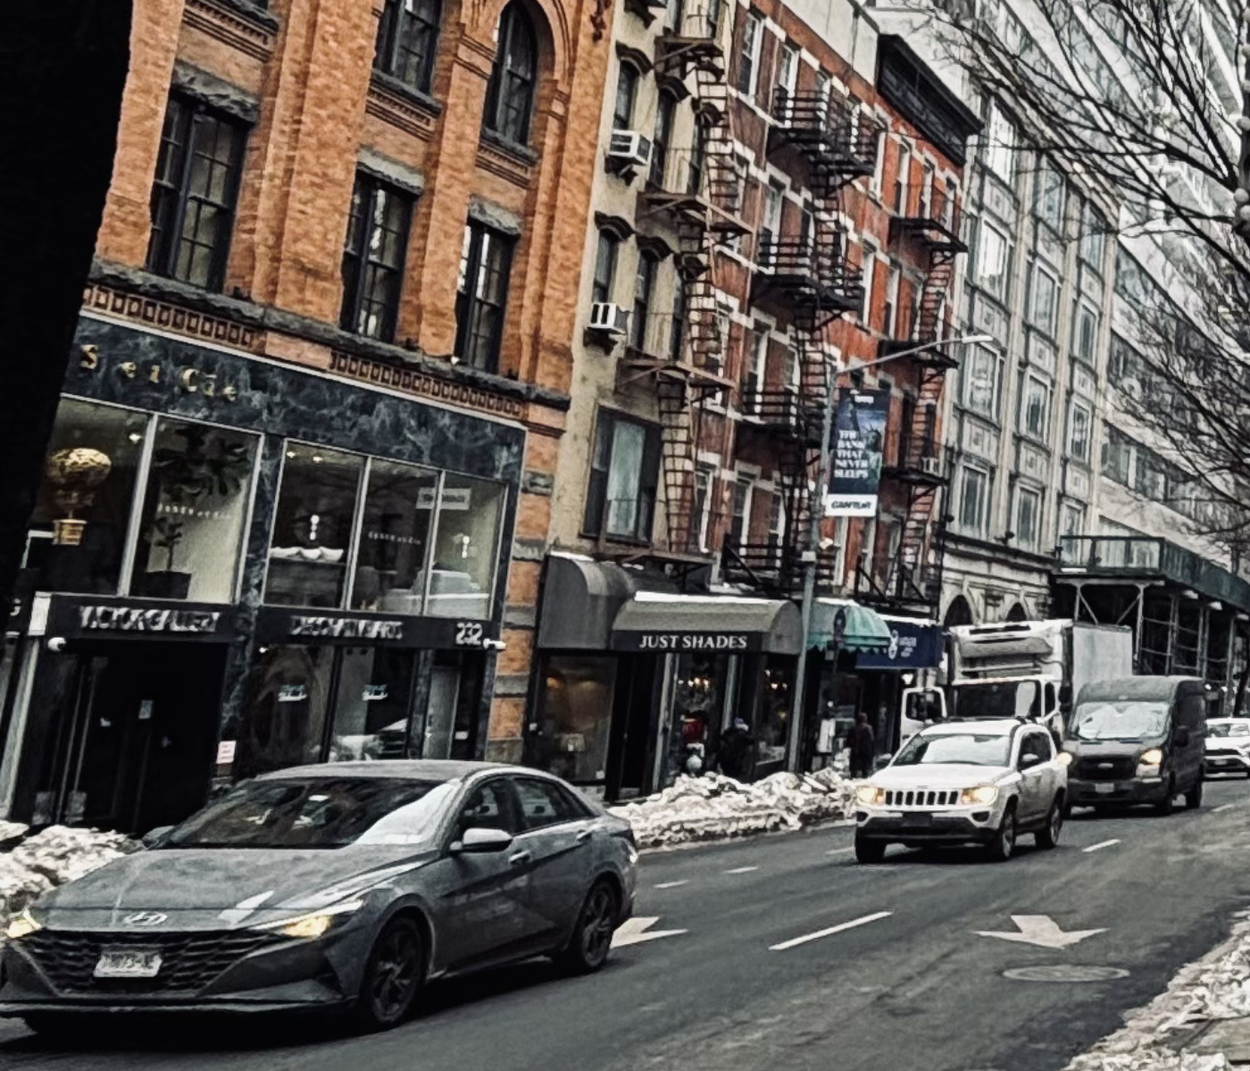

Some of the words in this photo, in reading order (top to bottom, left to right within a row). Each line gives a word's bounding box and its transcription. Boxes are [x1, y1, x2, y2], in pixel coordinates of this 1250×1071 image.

[836, 449, 864, 459] THAT
[835, 459, 869, 469] NEVER
[834, 469, 869, 479] SLEEPS
[454, 621, 484, 646] 232
[638, 633, 679, 650] JUST
[682, 634, 748, 650] SHADES
